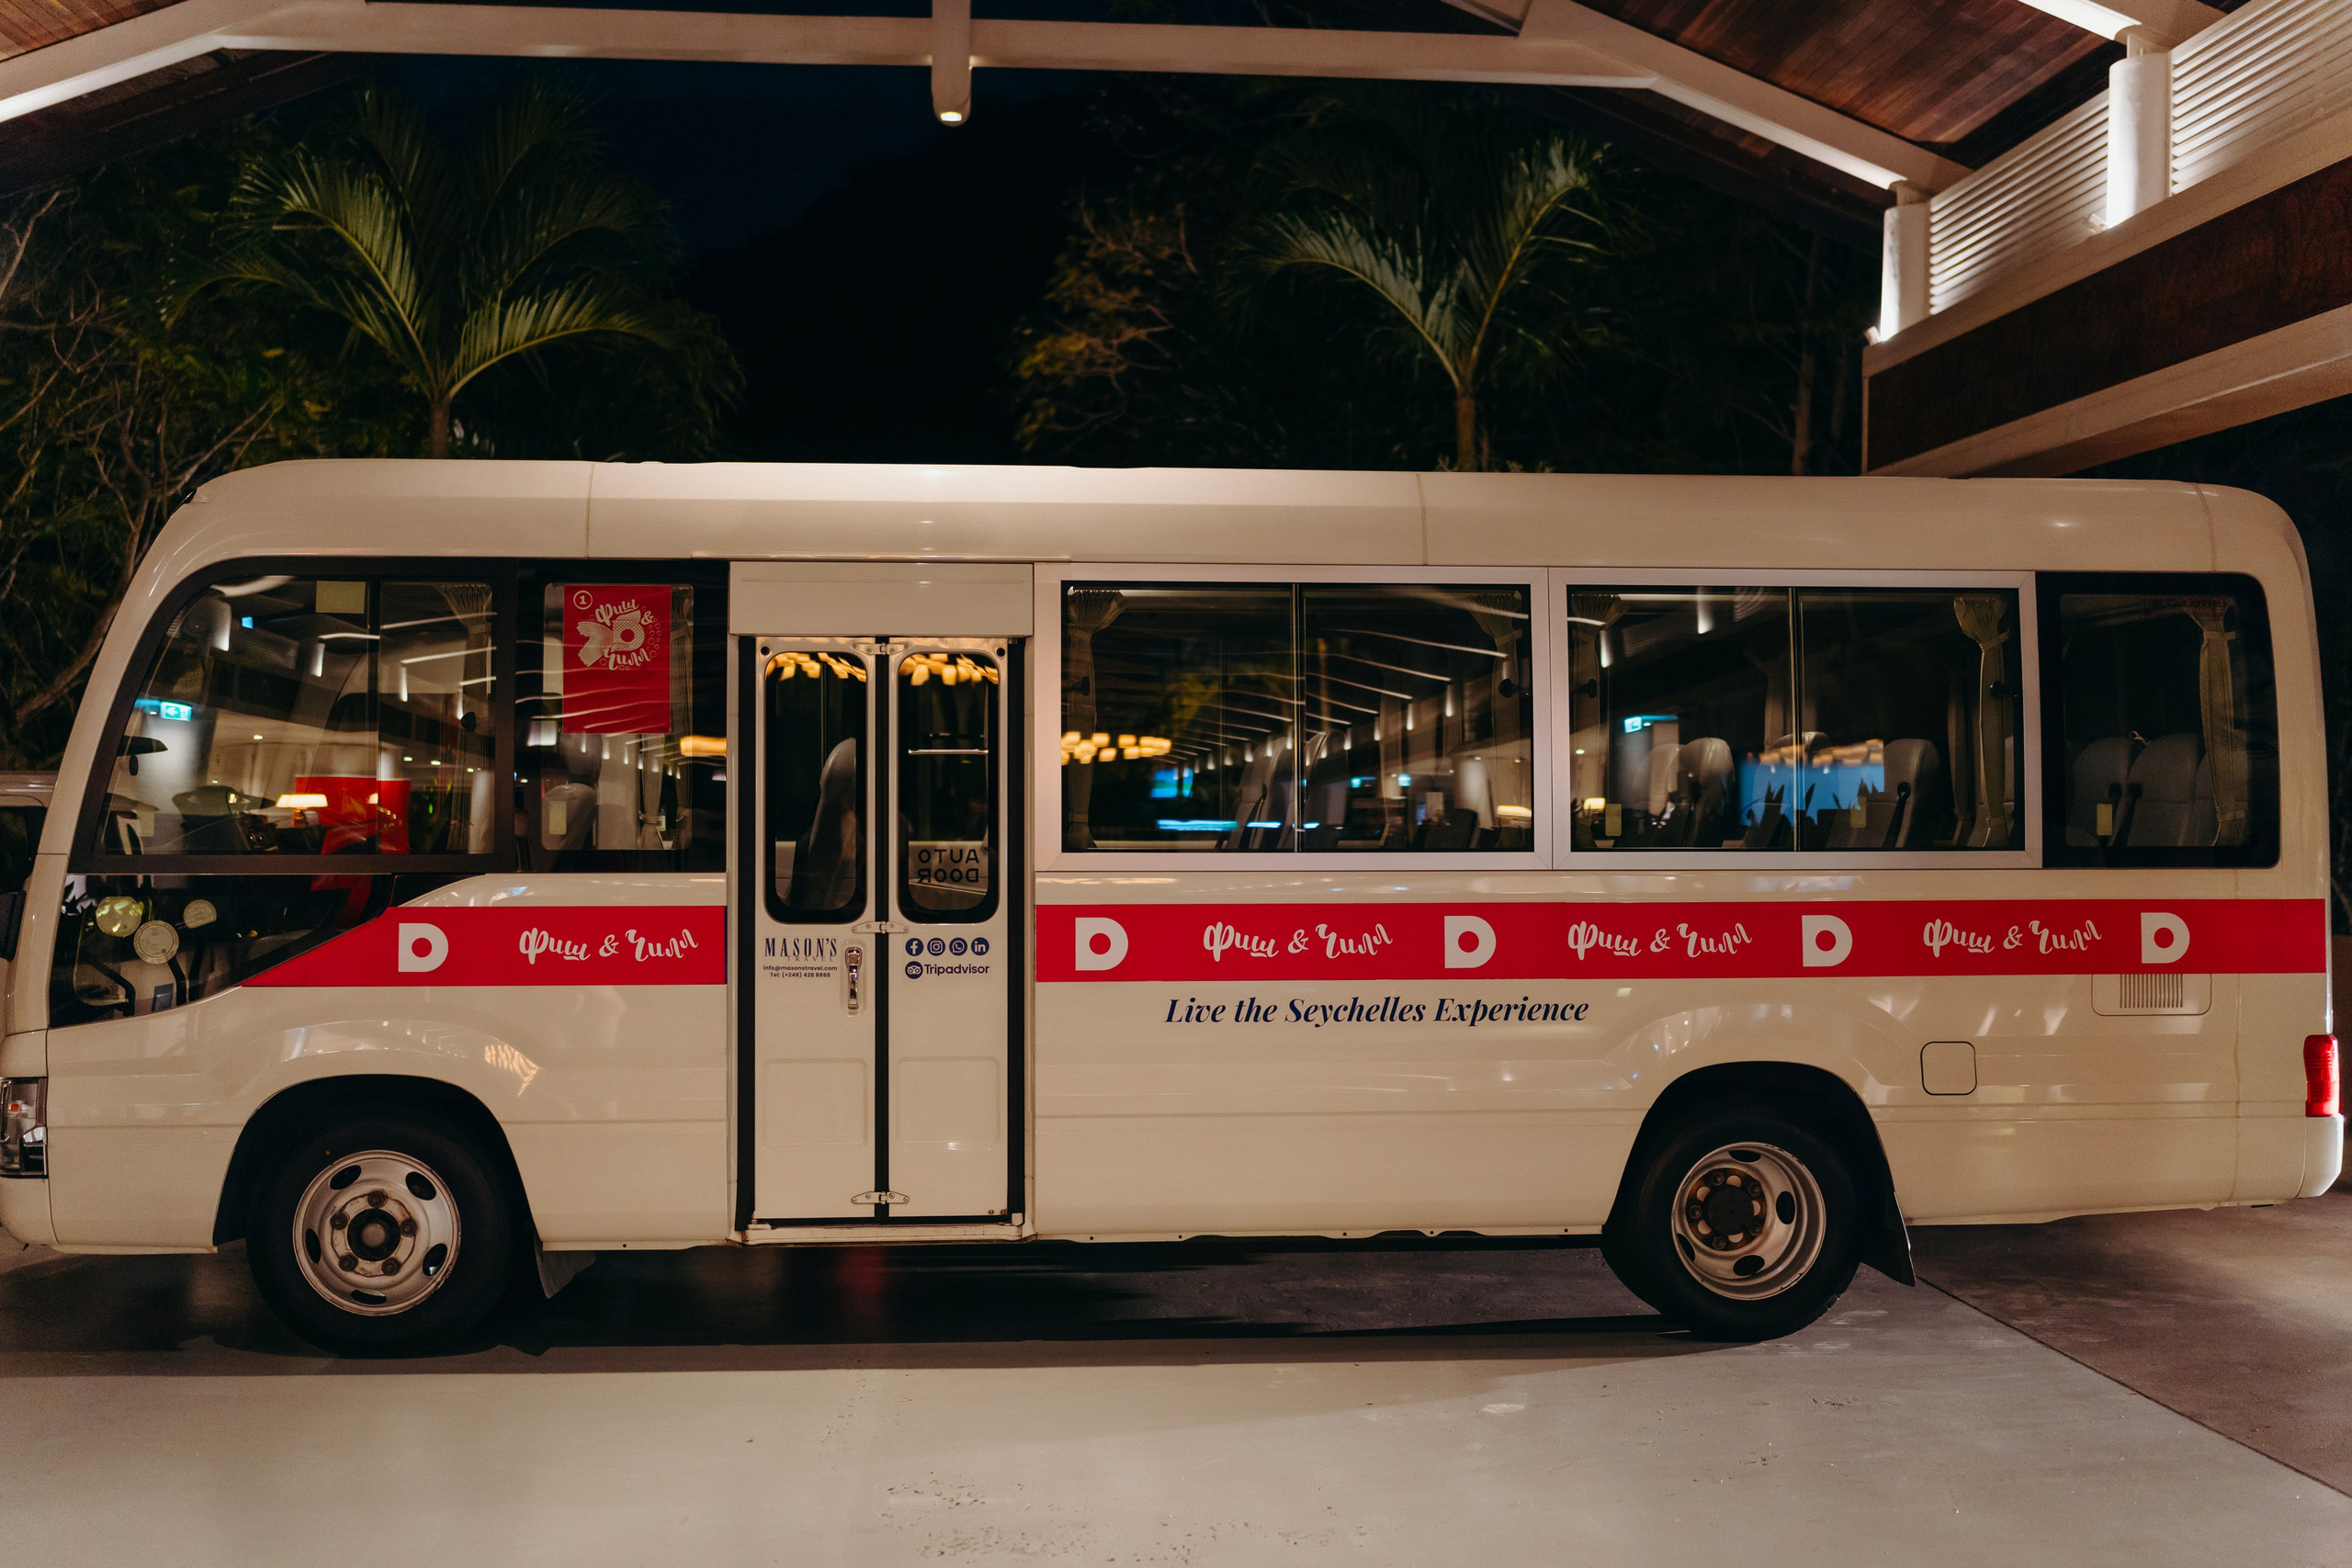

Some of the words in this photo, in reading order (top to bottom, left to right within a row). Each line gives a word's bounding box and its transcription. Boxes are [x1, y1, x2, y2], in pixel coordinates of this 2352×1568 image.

[640, 610, 655, 626] &
[519, 927, 591, 964] Фиш
[598, 934, 619, 957] &
[764, 938, 837, 957] MASON'S
[1203, 921, 1279, 962] Фиш
[1287, 929, 1309, 954] &
[1567, 921, 1642, 960] Фиш
[1649, 929, 1671, 953] &
[1923, 919, 1995, 957] Фиш
[2003, 926, 2023, 950] &
[782, 971, 802, 979] (+248)
[924, 964, 990, 976] Tripadvisor
[1164, 997, 1226, 1023] Live
[1234, 998, 1278, 1023] the
[1283, 996, 1426, 1028] Seychelles
[1432, 996, 1589, 1027] Experience
